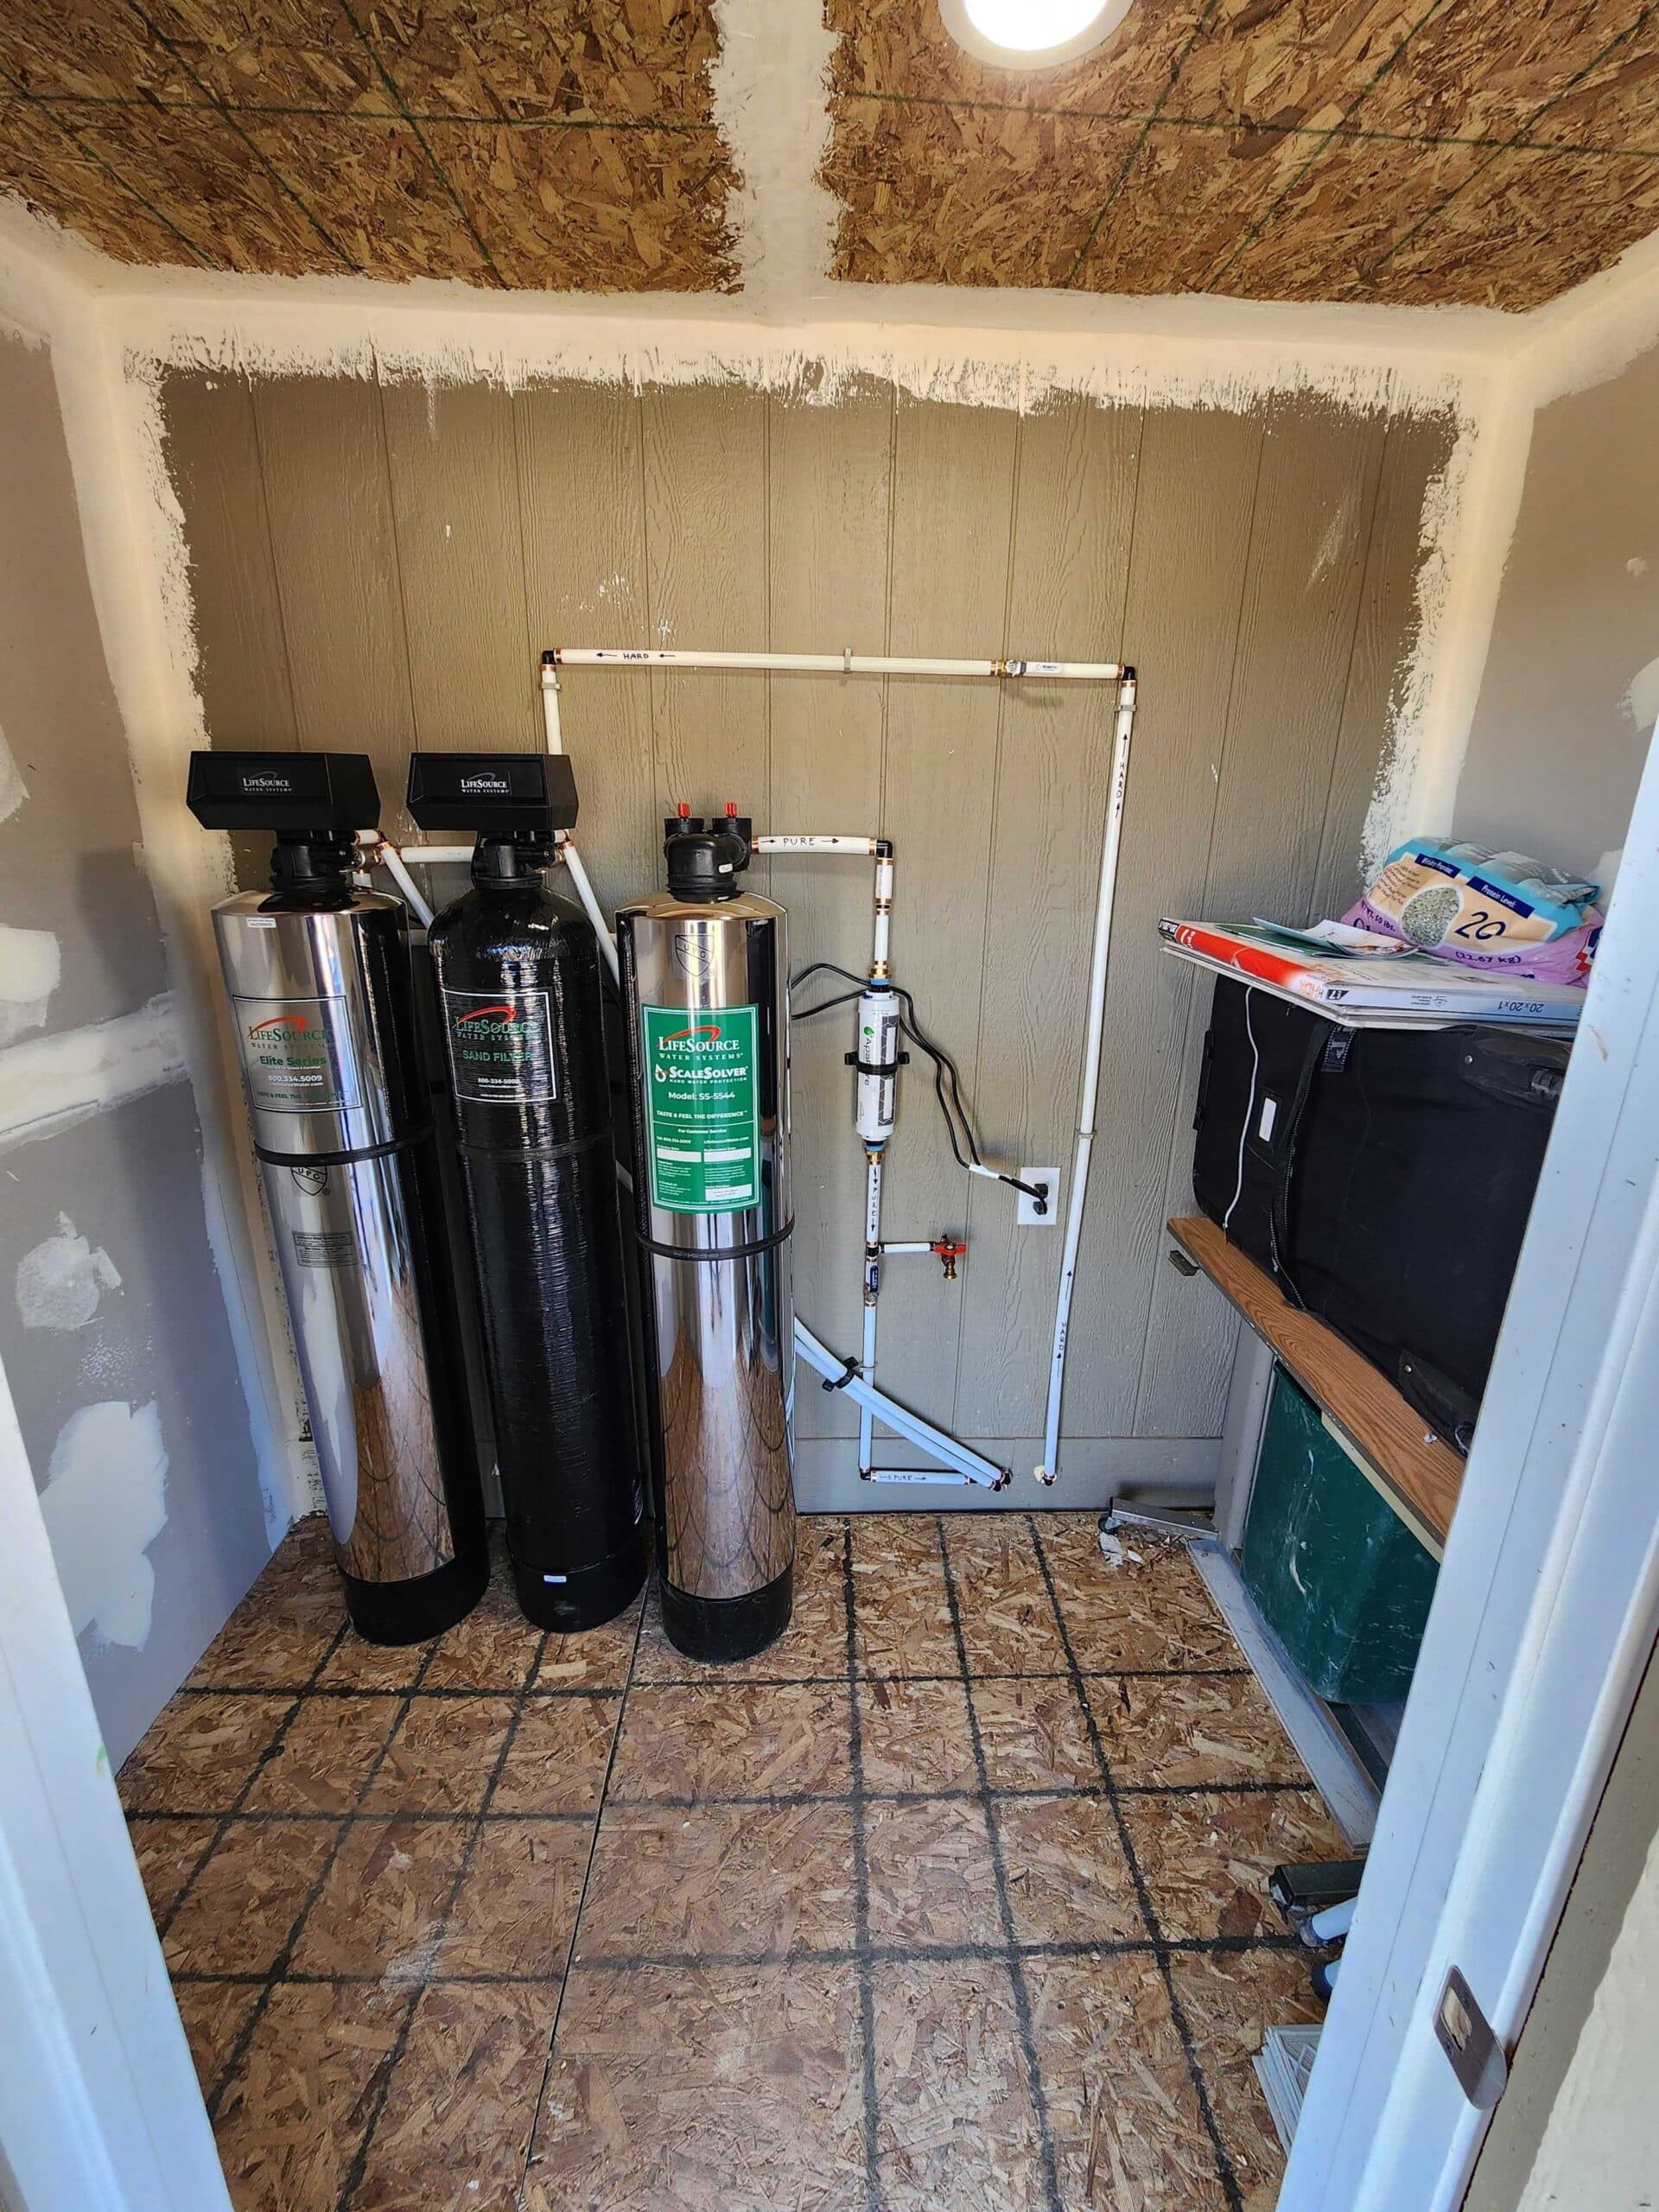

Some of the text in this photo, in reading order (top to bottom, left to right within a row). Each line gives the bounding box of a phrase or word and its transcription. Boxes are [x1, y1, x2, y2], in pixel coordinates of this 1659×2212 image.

[783, 837, 816, 847] PURE
[1454, 911, 1507, 941] 20
[259, 1055, 327, 1066] Elite Series
[461, 1050, 491, 1062] SAND
[659, 1052, 742, 1061] WATER SYSTEMS
[668, 1091, 697, 1101] Model:
[297, 1167, 321, 1180] UPC
[1058, 1321, 1067, 1351] HARD
